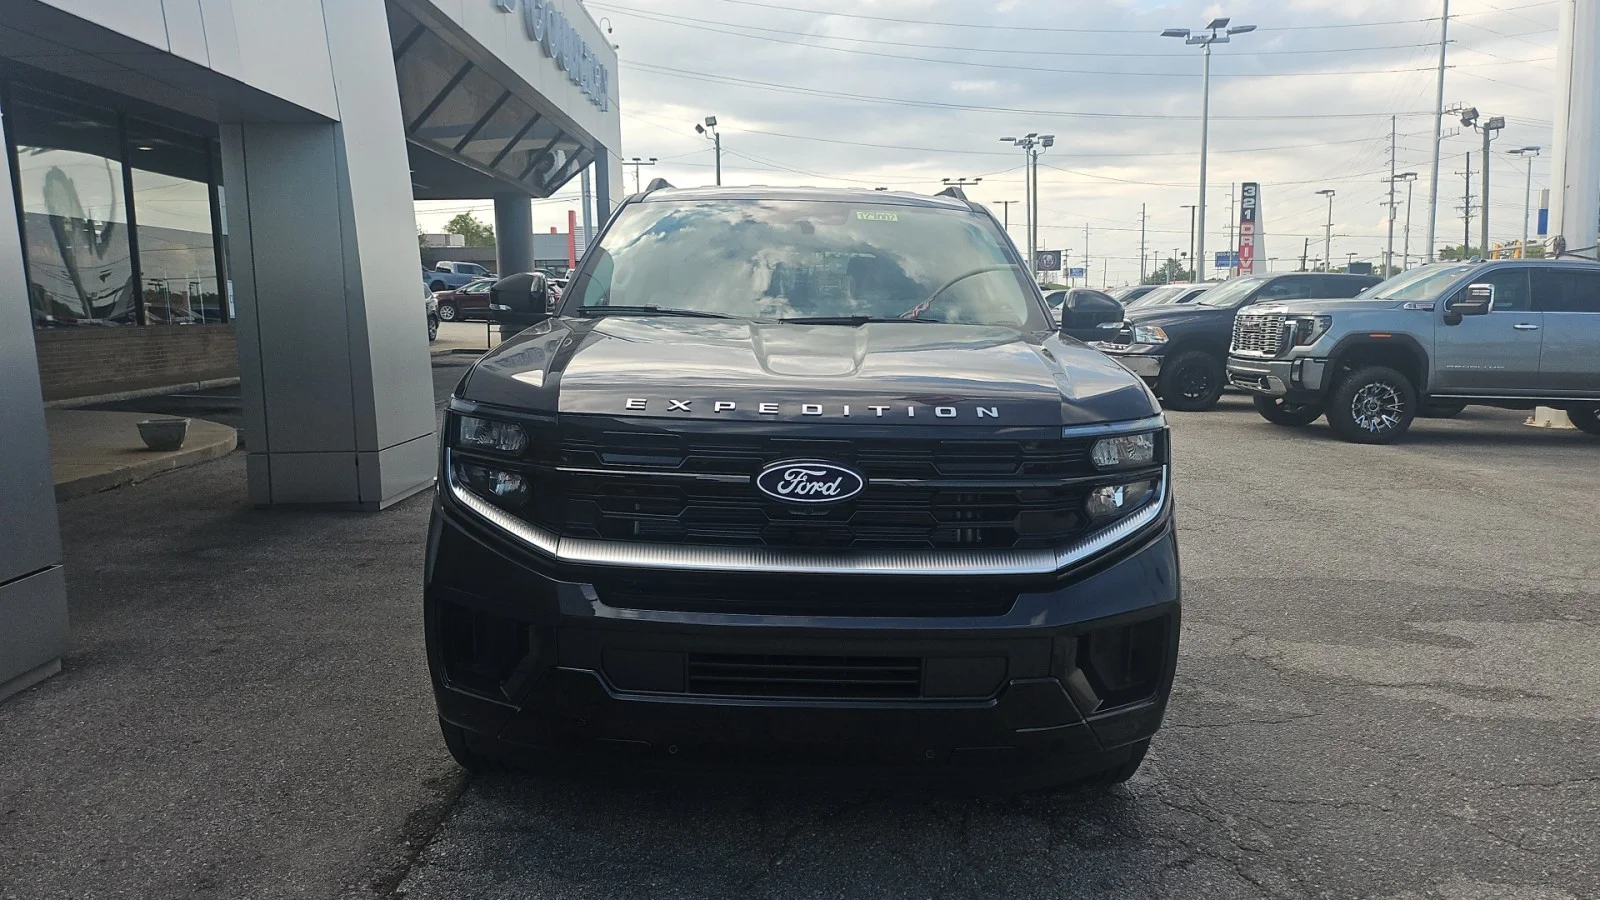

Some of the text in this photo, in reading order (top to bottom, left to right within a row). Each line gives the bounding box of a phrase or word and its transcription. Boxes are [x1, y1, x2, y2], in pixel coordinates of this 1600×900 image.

[1243, 186, 1256, 220] 321
[625, 398, 999, 418] EXPEDITION
[776, 468, 841, 497] Ford
